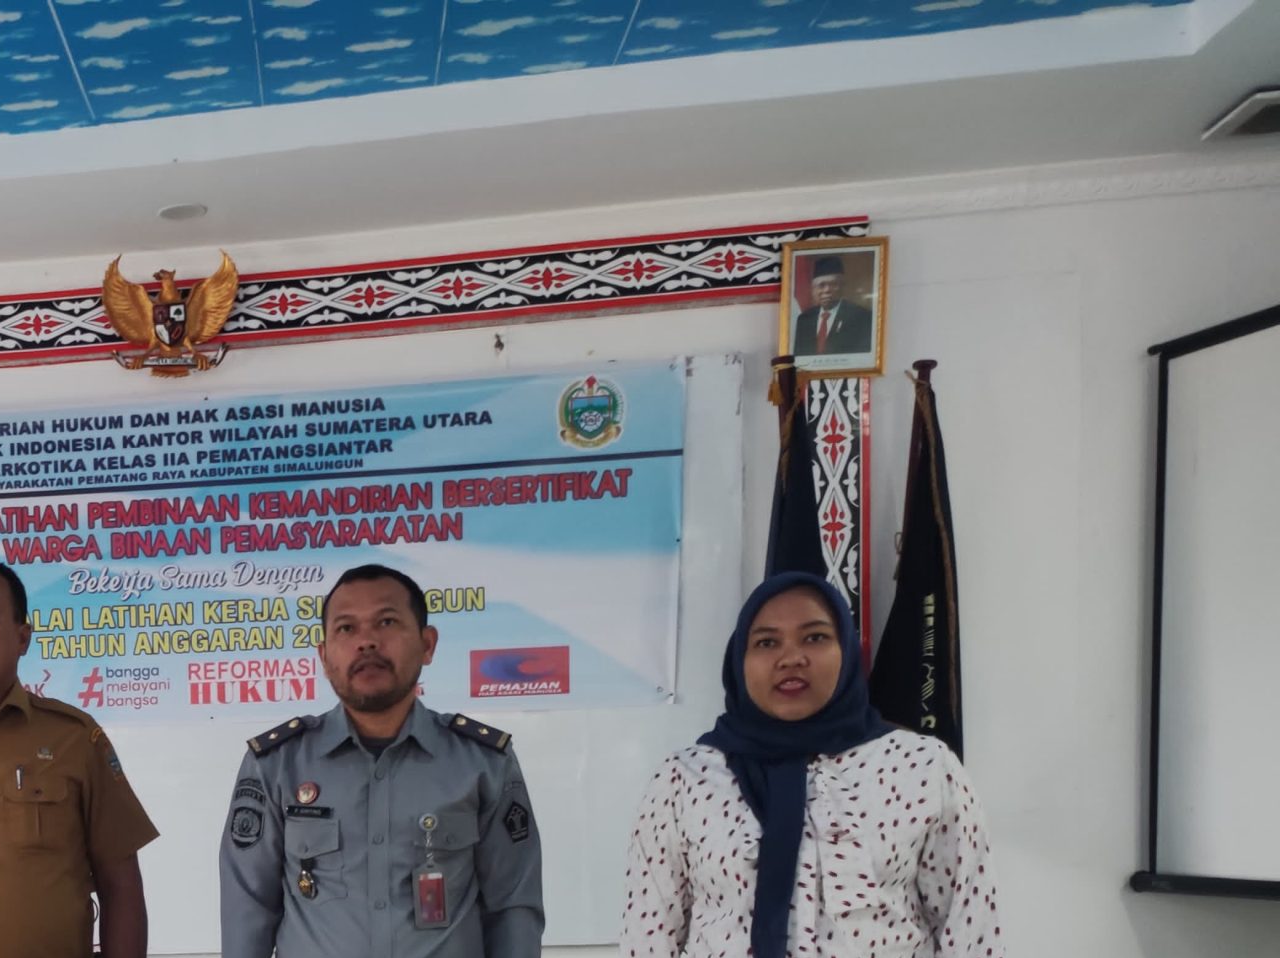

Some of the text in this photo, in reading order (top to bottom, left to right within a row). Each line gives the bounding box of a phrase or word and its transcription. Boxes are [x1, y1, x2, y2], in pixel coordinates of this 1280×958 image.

[52, 415, 123, 434] HUKUM
[130, 412, 170, 428] DAN
[176, 408, 218, 425] HAK
[225, 403, 284, 421] ASASI
[291, 397, 386, 417] MANUSIA
[10, 436, 116, 456] INDONESIA
[122, 430, 204, 449] KANTOR
[209, 424, 298, 443] WILAYAH
[304, 416, 416, 437] SUMATERA
[422, 410, 493, 429] UTARA
[93, 454, 156, 471] KELAS
[163, 452, 190, 466] IIA
[196, 438, 394, 465] PEMATANGSIANTAR
[77, 472, 148, 486] PEMATANG
[152, 470, 185, 481] RAYA
[190, 464, 269, 479] KABUPATEN
[273, 458, 364, 474] SIMALUNGUN
[87, 493, 240, 530] PEMBINAAN
[249, 482, 433, 520] KEMANDIRIAN
[442, 468, 632, 509] BERSERTIFIKAT
[4, 534, 102, 565] WARGA
[110, 527, 211, 560] BINAAN
[220, 512, 463, 554] PEMASYARAKATAN
[69, 560, 324, 601] Bekerja Sama Dengan
[82, 601, 194, 630] LATIHAN
[203, 597, 289, 624] KERJA
[36, 633, 126, 660] TAHUN
[134, 626, 284, 656] ANGGARAN
[106, 667, 160, 681] bangga
[187, 658, 316, 680] REFORMASI
[106, 678, 170, 695] melayani
[107, 695, 159, 709] bangsa
[189, 678, 316, 705] HUKUM
[479, 681, 561, 692] PEMAJUAN
